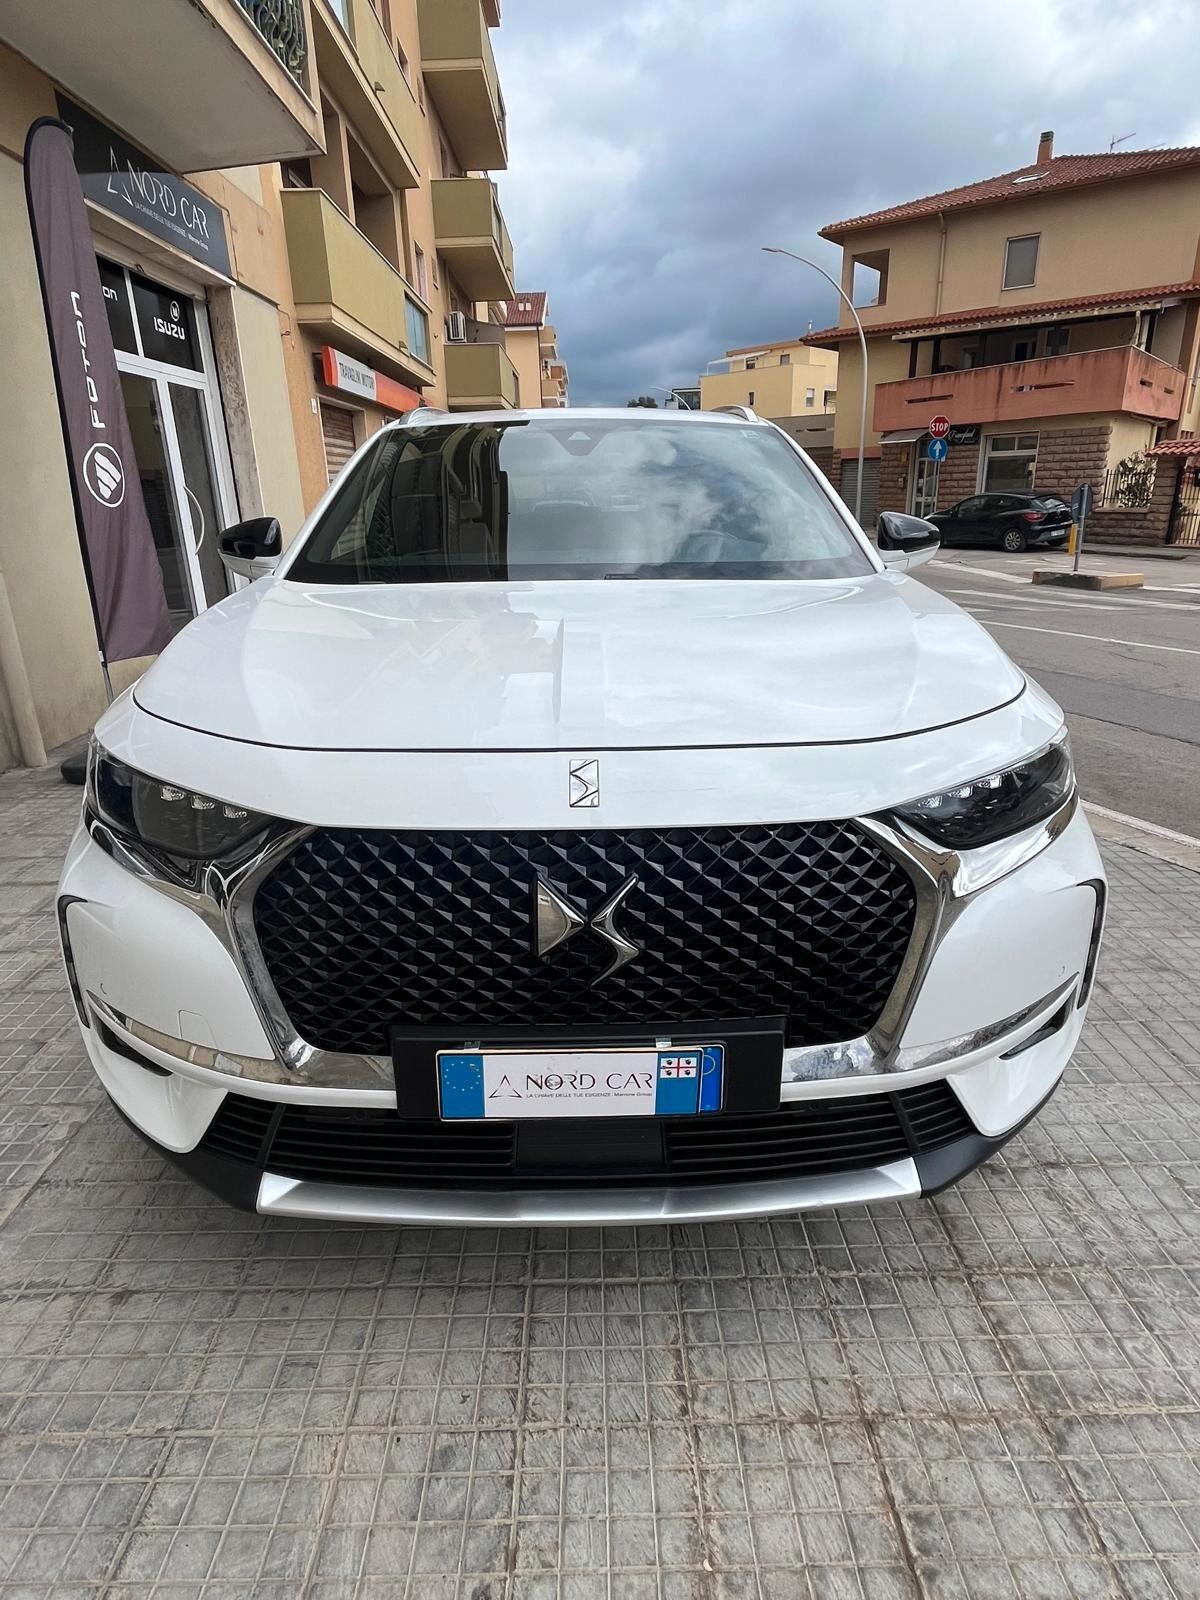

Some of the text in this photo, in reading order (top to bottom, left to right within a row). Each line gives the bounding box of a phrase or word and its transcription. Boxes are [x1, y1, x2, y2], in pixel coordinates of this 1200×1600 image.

[126, 158, 177, 217] NORD
[181, 197, 210, 239] CAR
[153, 316, 186, 340] ISUZU
[931, 422, 948, 432] STOP
[526, 1072, 653, 1091] NORD CAR
